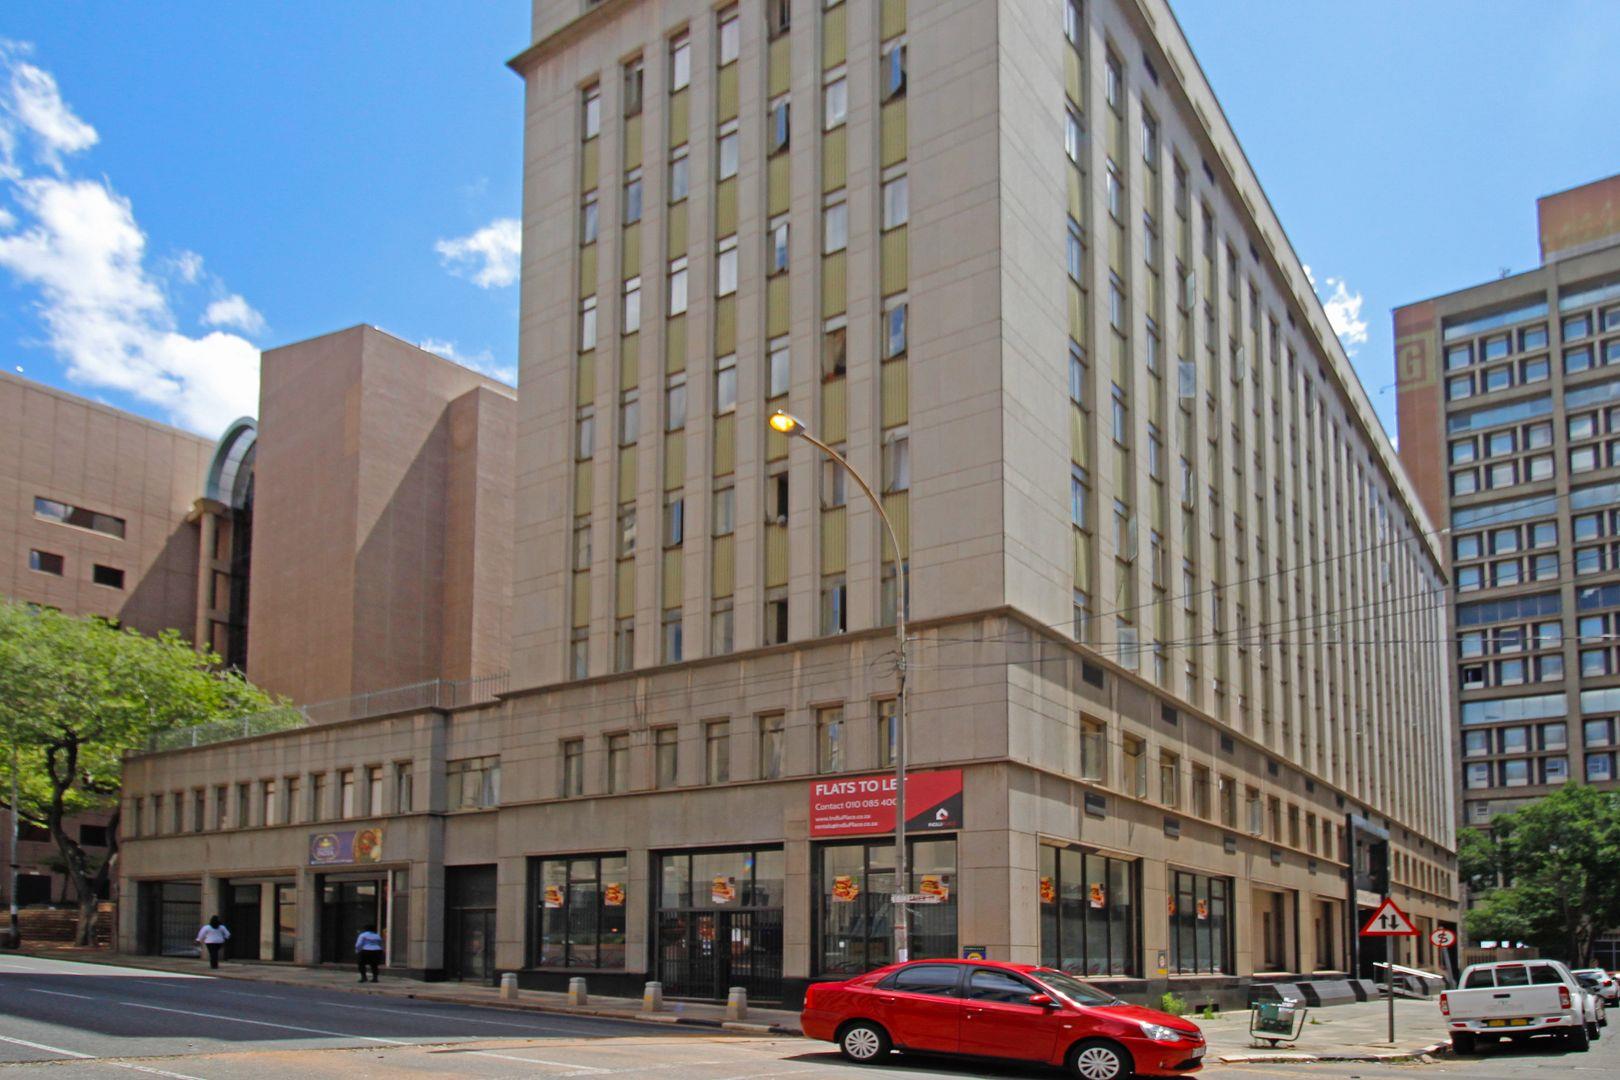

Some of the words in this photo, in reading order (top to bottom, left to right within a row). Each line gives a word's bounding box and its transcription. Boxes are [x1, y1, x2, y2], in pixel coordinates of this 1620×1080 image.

[816, 782, 856, 796] FLATS
[859, 780, 879, 793] TO
[882, 778, 908, 791] LE
[815, 803, 844, 811] Contact
